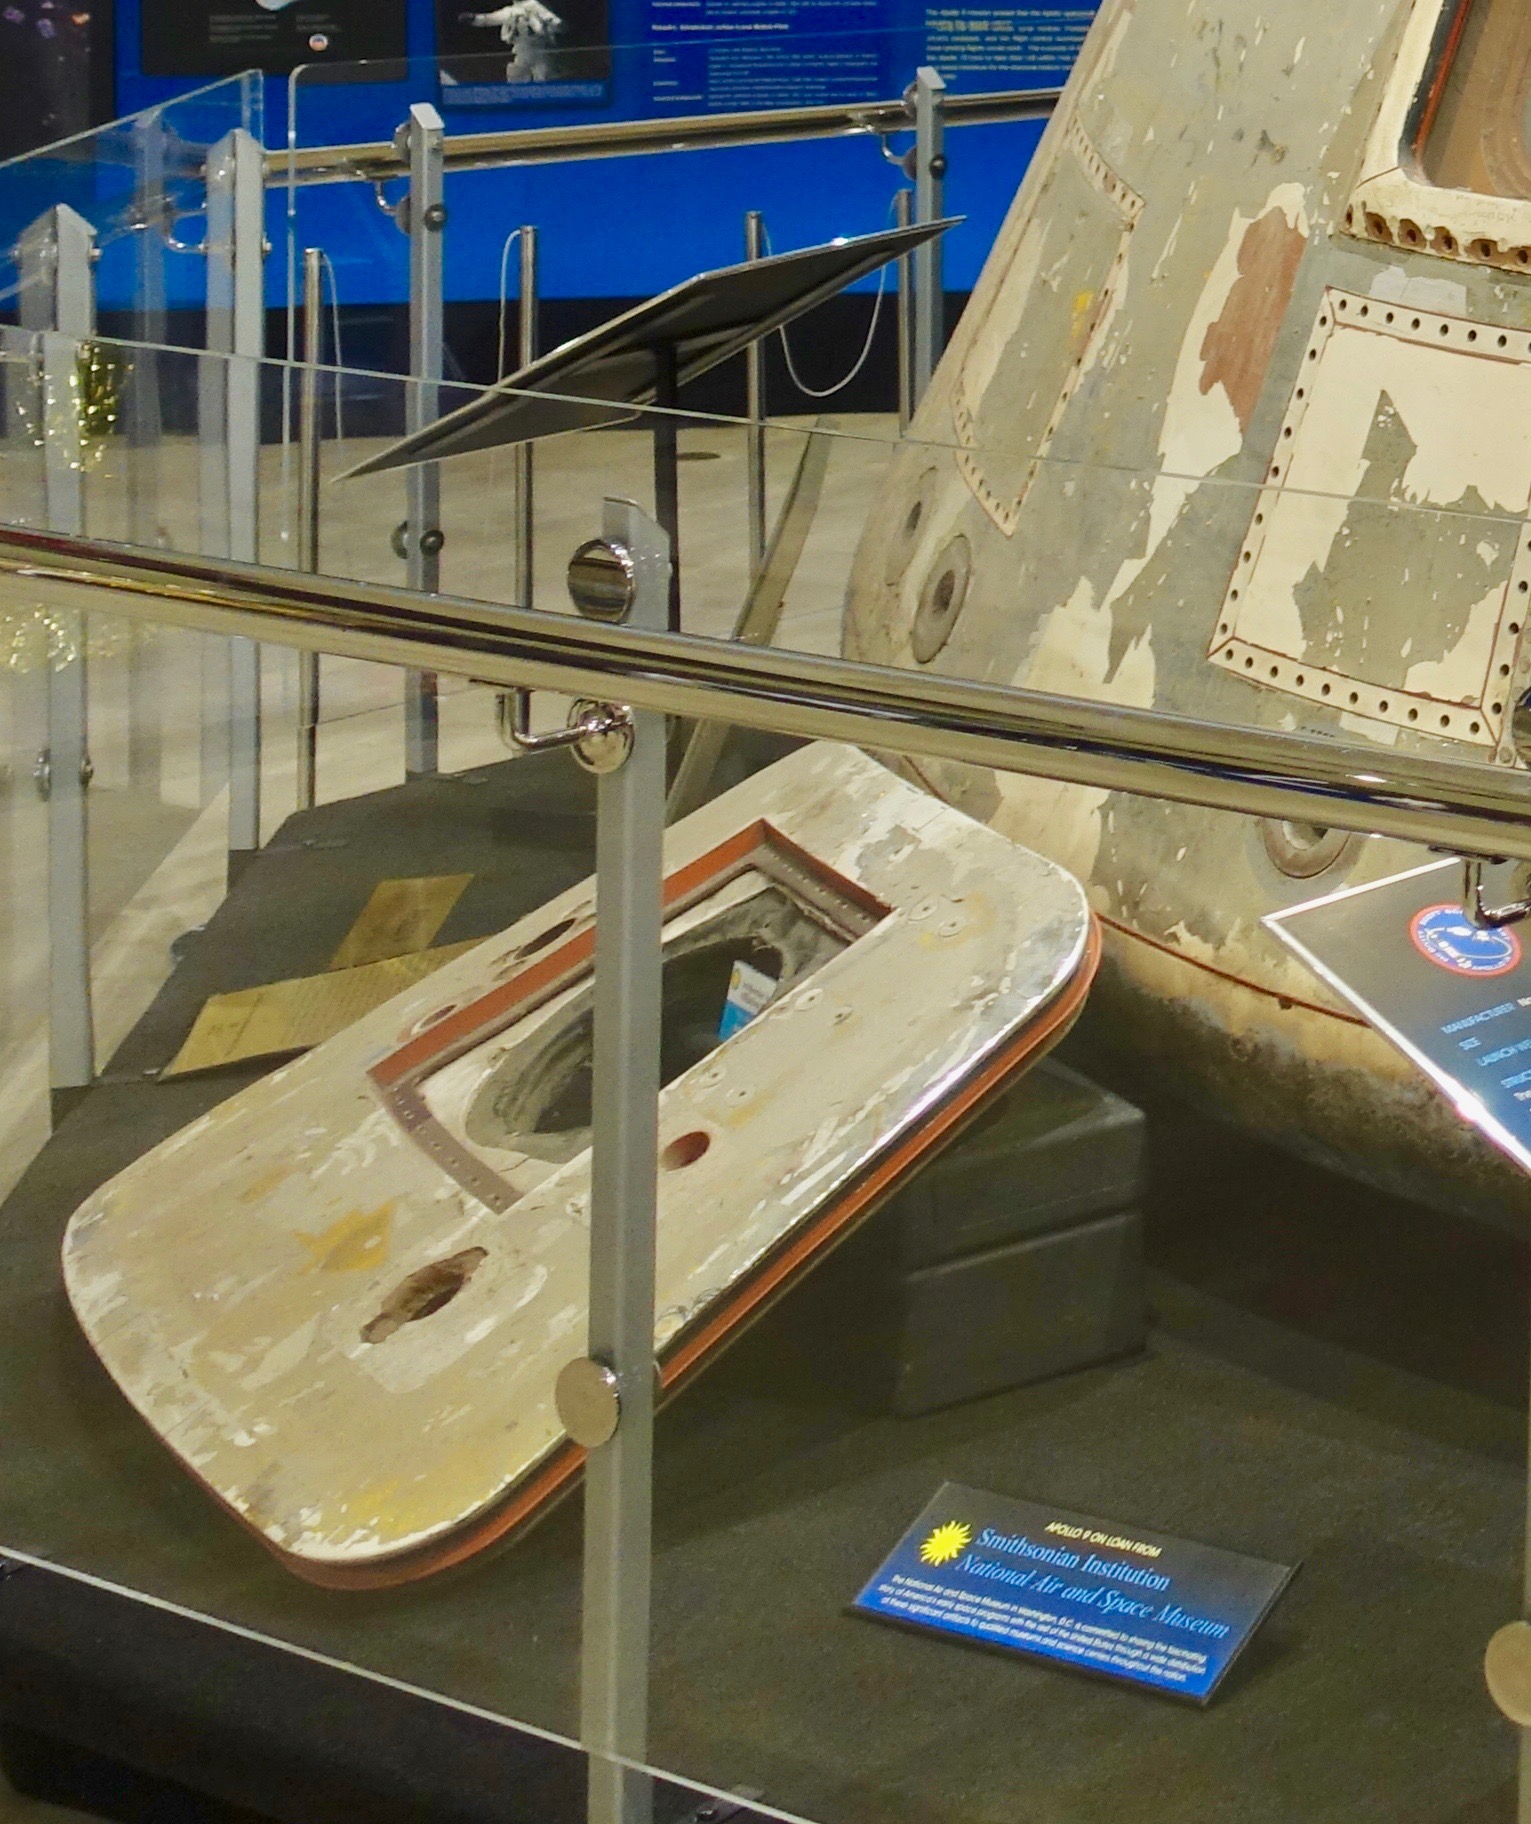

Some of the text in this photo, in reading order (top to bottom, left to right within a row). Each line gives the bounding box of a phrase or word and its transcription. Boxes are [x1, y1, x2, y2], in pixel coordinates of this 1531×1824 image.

[977, 1529, 1168, 1589] Smithsonian Institution
[1045, 1523, 1082, 1538] APOLLO
[1090, 1532, 1107, 1544] ON
[1106, 1537, 1133, 1550] LOAN
[1132, 1542, 1161, 1556] FROM
[956, 1555, 1228, 1637] National Air and Space Museum
